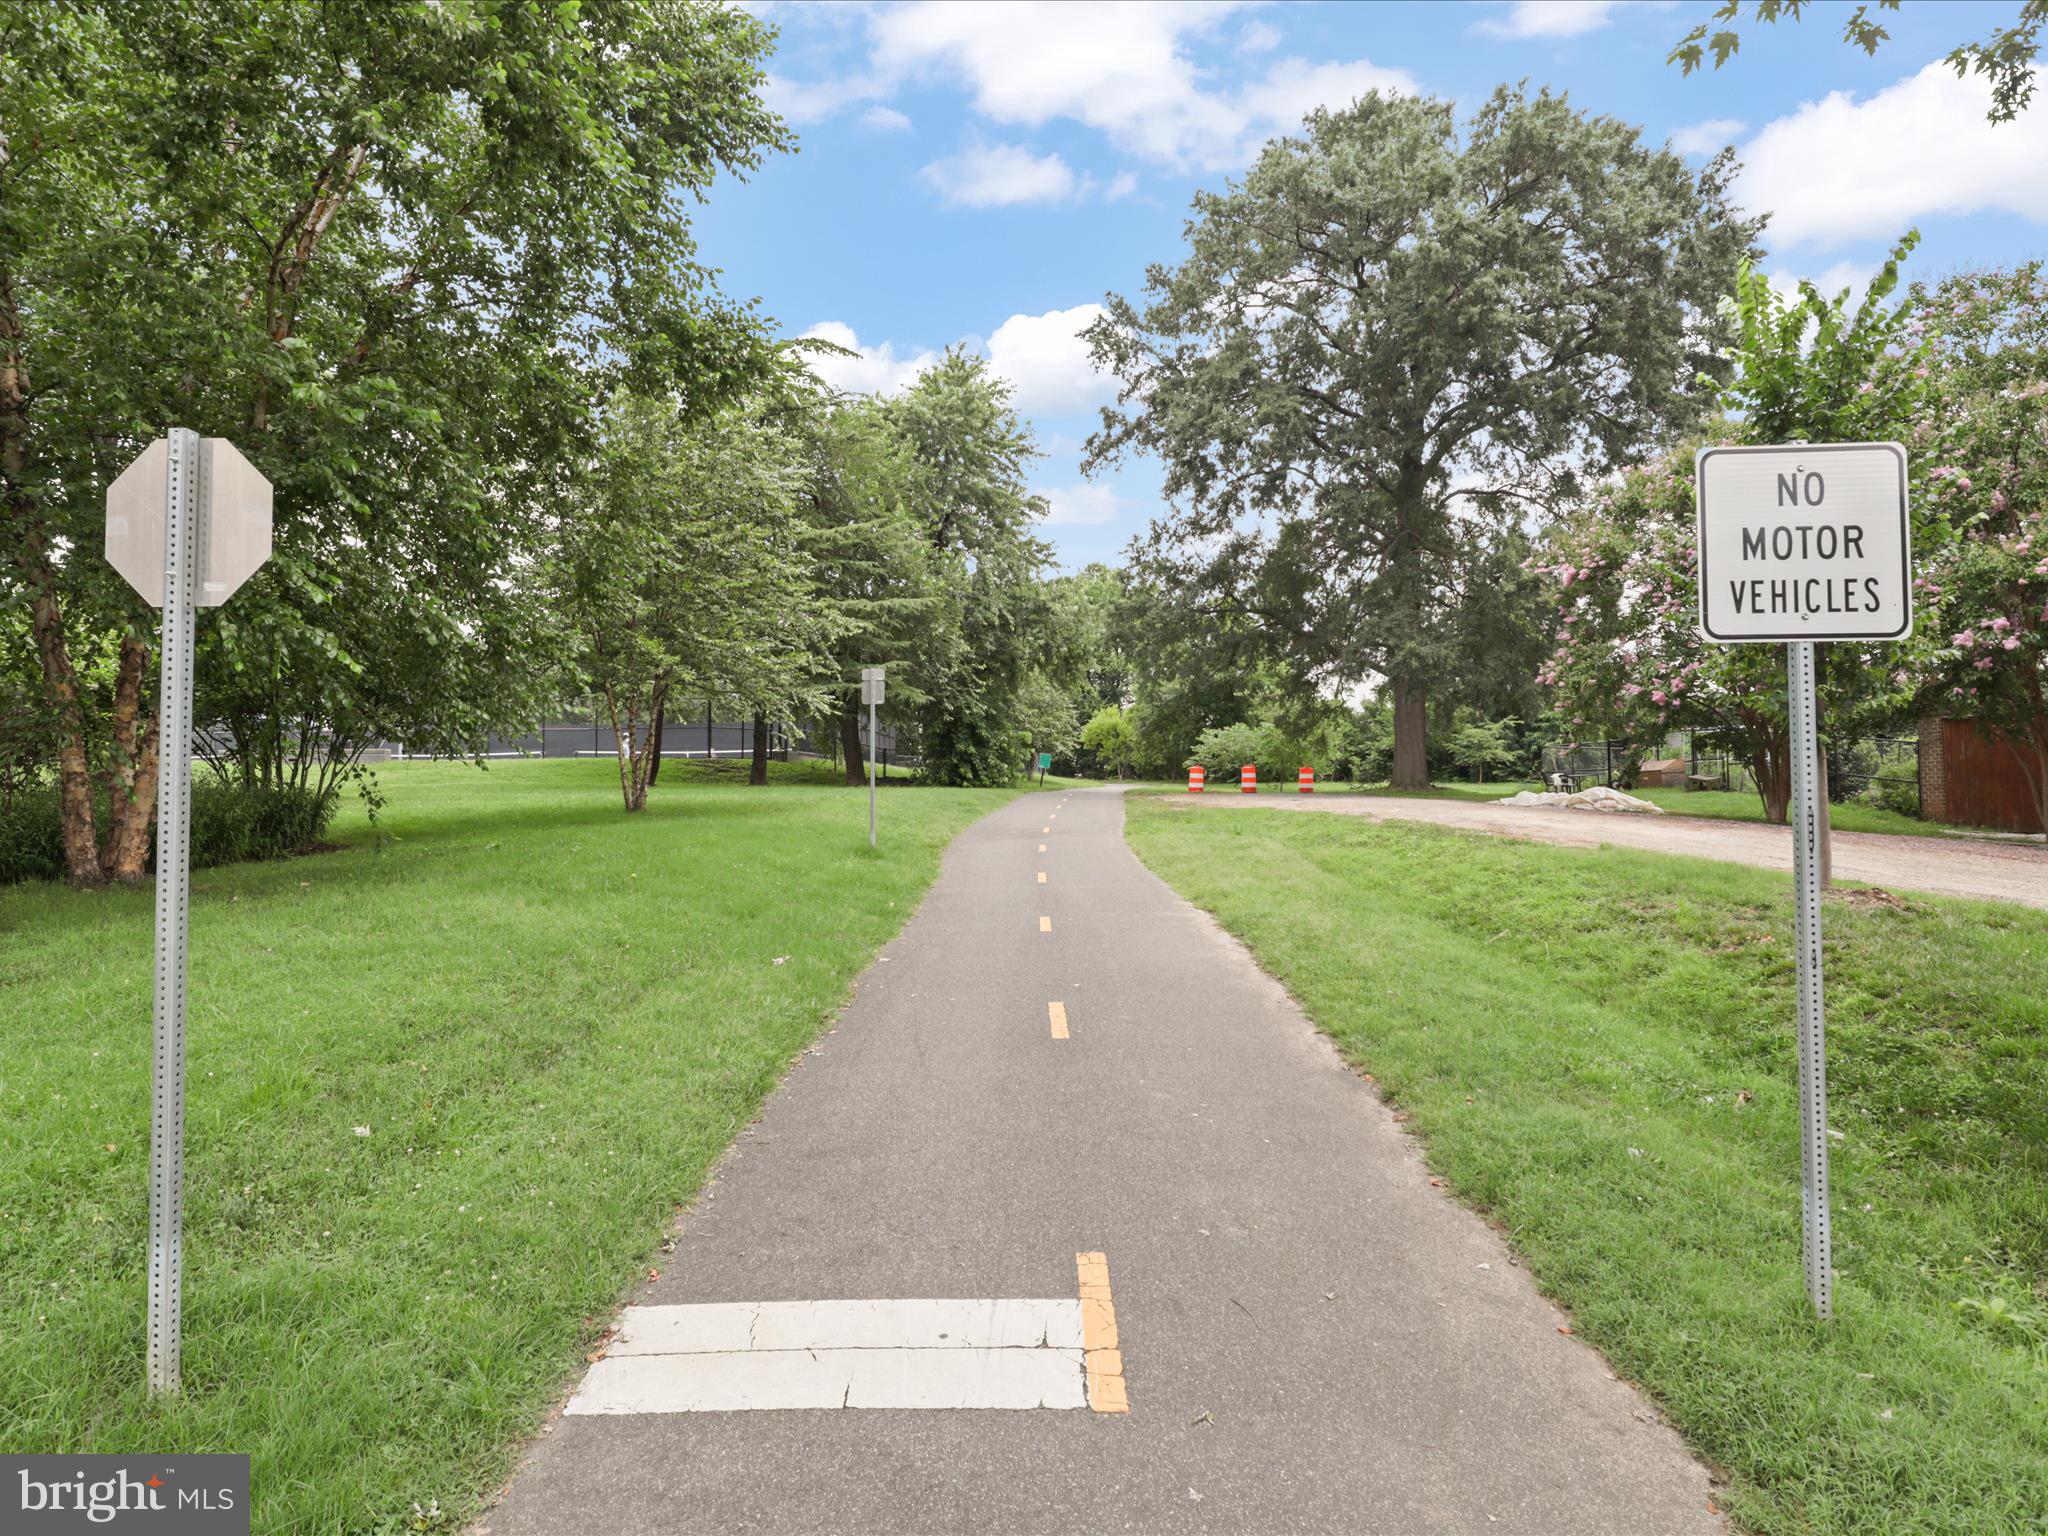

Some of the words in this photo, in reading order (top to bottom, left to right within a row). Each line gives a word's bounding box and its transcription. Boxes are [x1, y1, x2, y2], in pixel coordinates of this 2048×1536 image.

[1777, 472, 1824, 506] NO
[1742, 525, 1864, 560] MOTOR
[1730, 577, 1880, 614] VEHICLES
